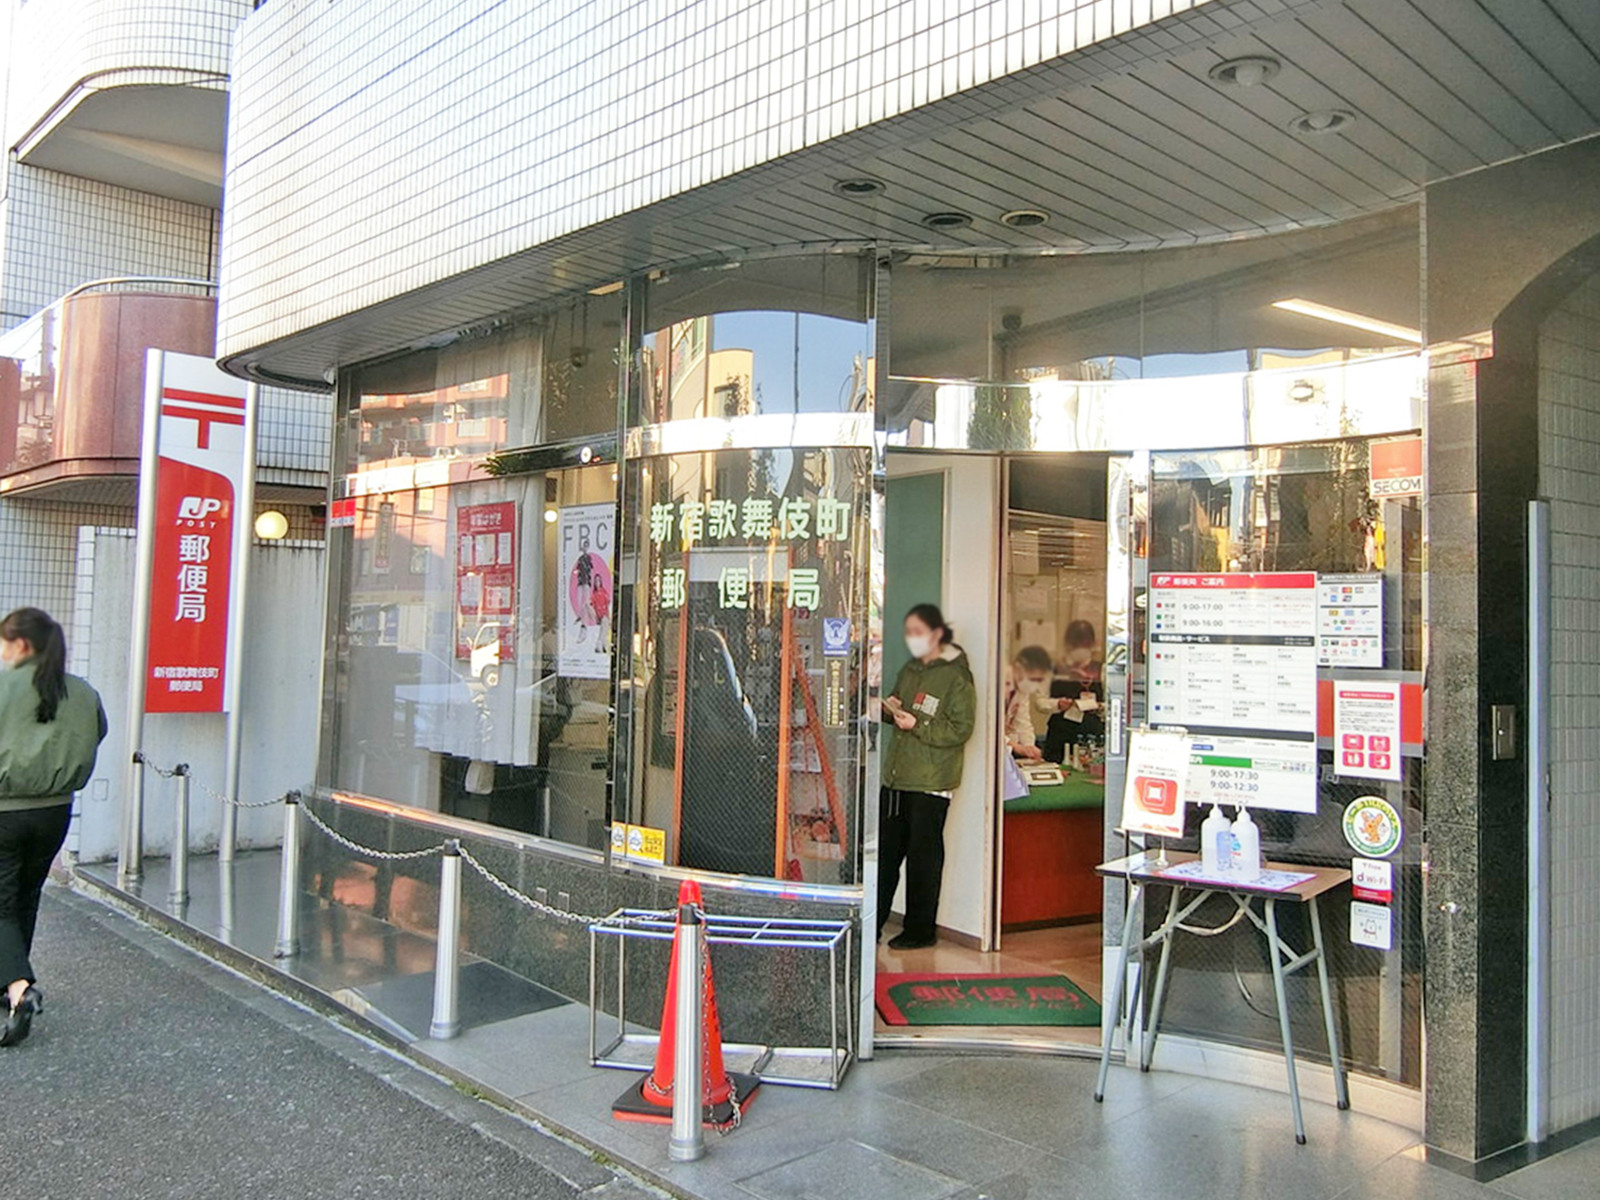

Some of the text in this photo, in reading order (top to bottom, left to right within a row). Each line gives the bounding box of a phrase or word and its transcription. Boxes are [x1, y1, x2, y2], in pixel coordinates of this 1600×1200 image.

[1374, 478, 1421, 493] SECOM
[176, 519, 216, 528] POST
[650, 496, 851, 542] 新宿歌舞伎町
[563, 522, 608, 553] FBC
[174, 534, 211, 623] 郵便局
[1201, 577, 1225, 586] ご案内
[661, 567, 821, 611] 郵便局
[153, 666, 219, 679] 新宿歌舞伎町
[168, 680, 204, 692] 郵便局
